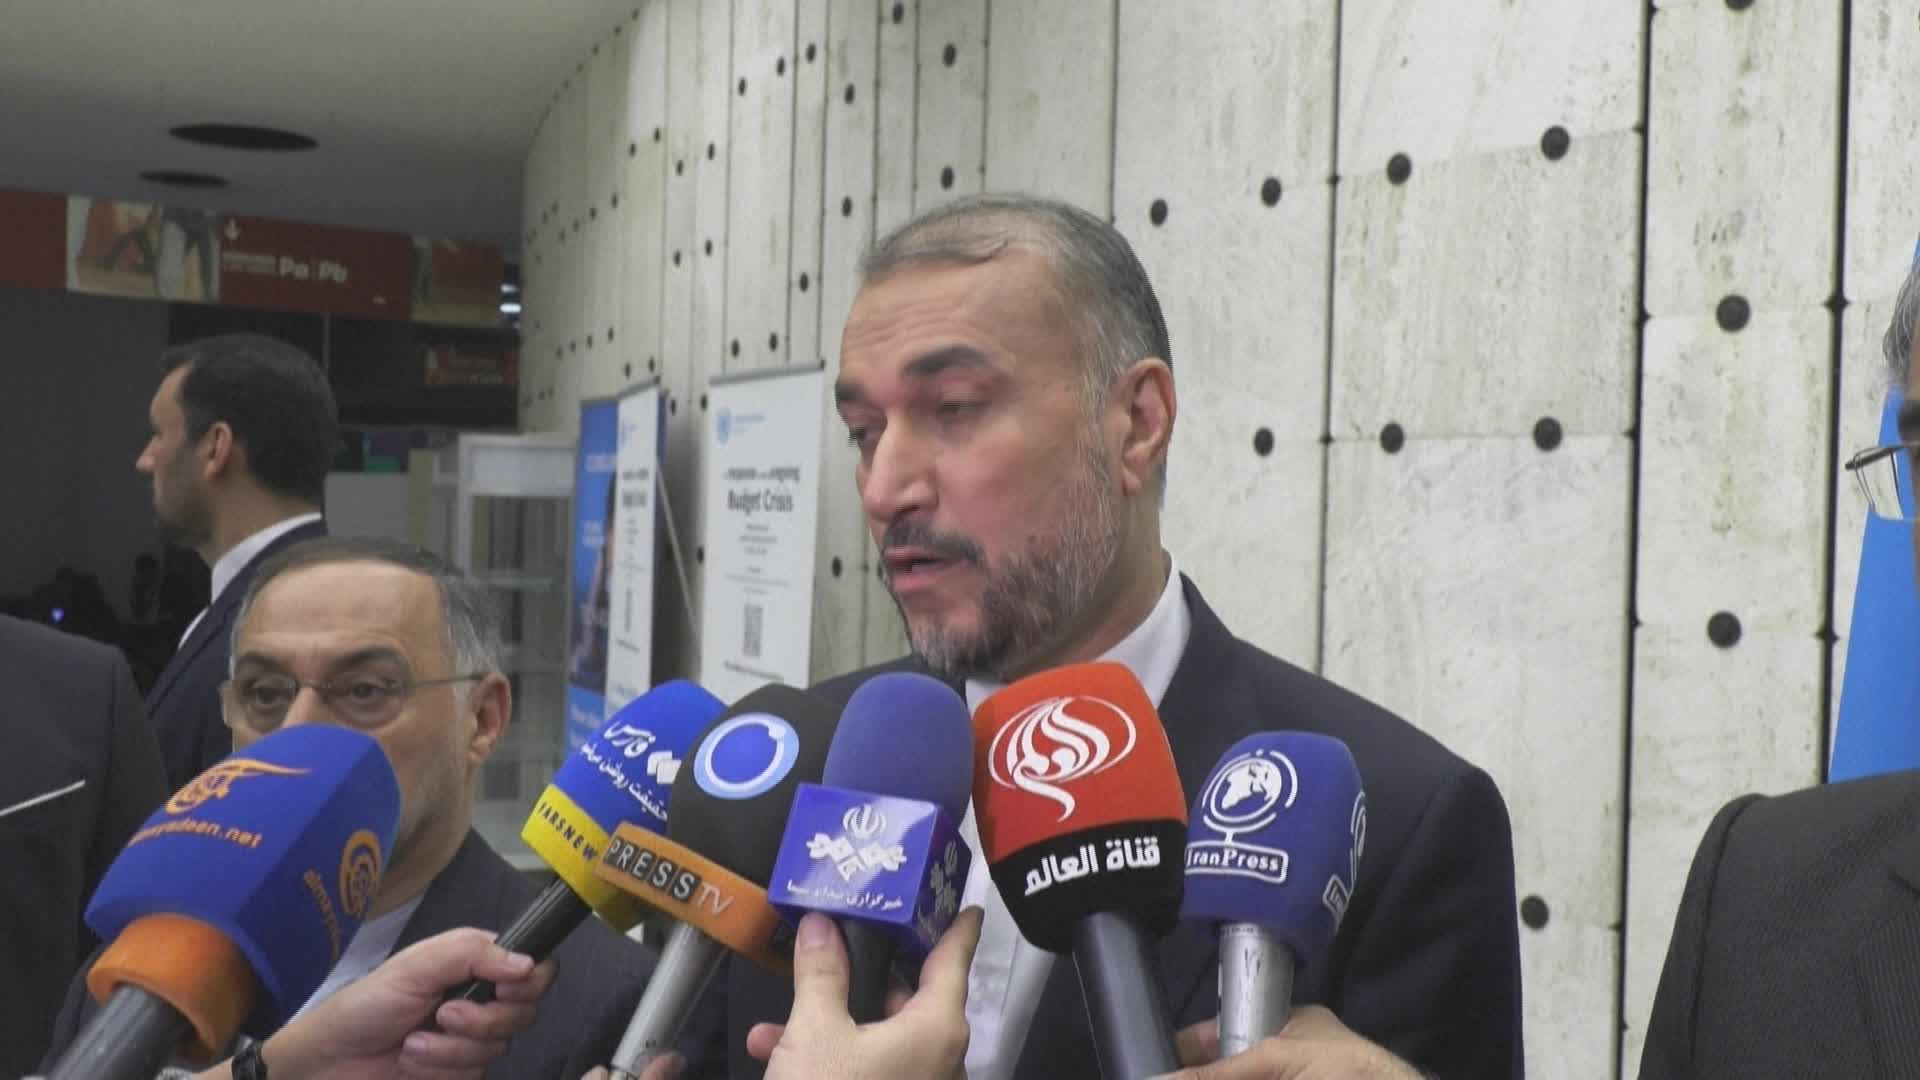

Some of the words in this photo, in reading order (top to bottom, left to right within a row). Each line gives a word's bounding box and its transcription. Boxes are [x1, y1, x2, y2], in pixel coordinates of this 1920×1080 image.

[728, 490, 761, 516] Budget
[763, 490, 794, 513] Crisis
[606, 838, 696, 900] PRESS
[1023, 843, 1099, 896] العالم
[1105, 836, 1160, 871] قناة
